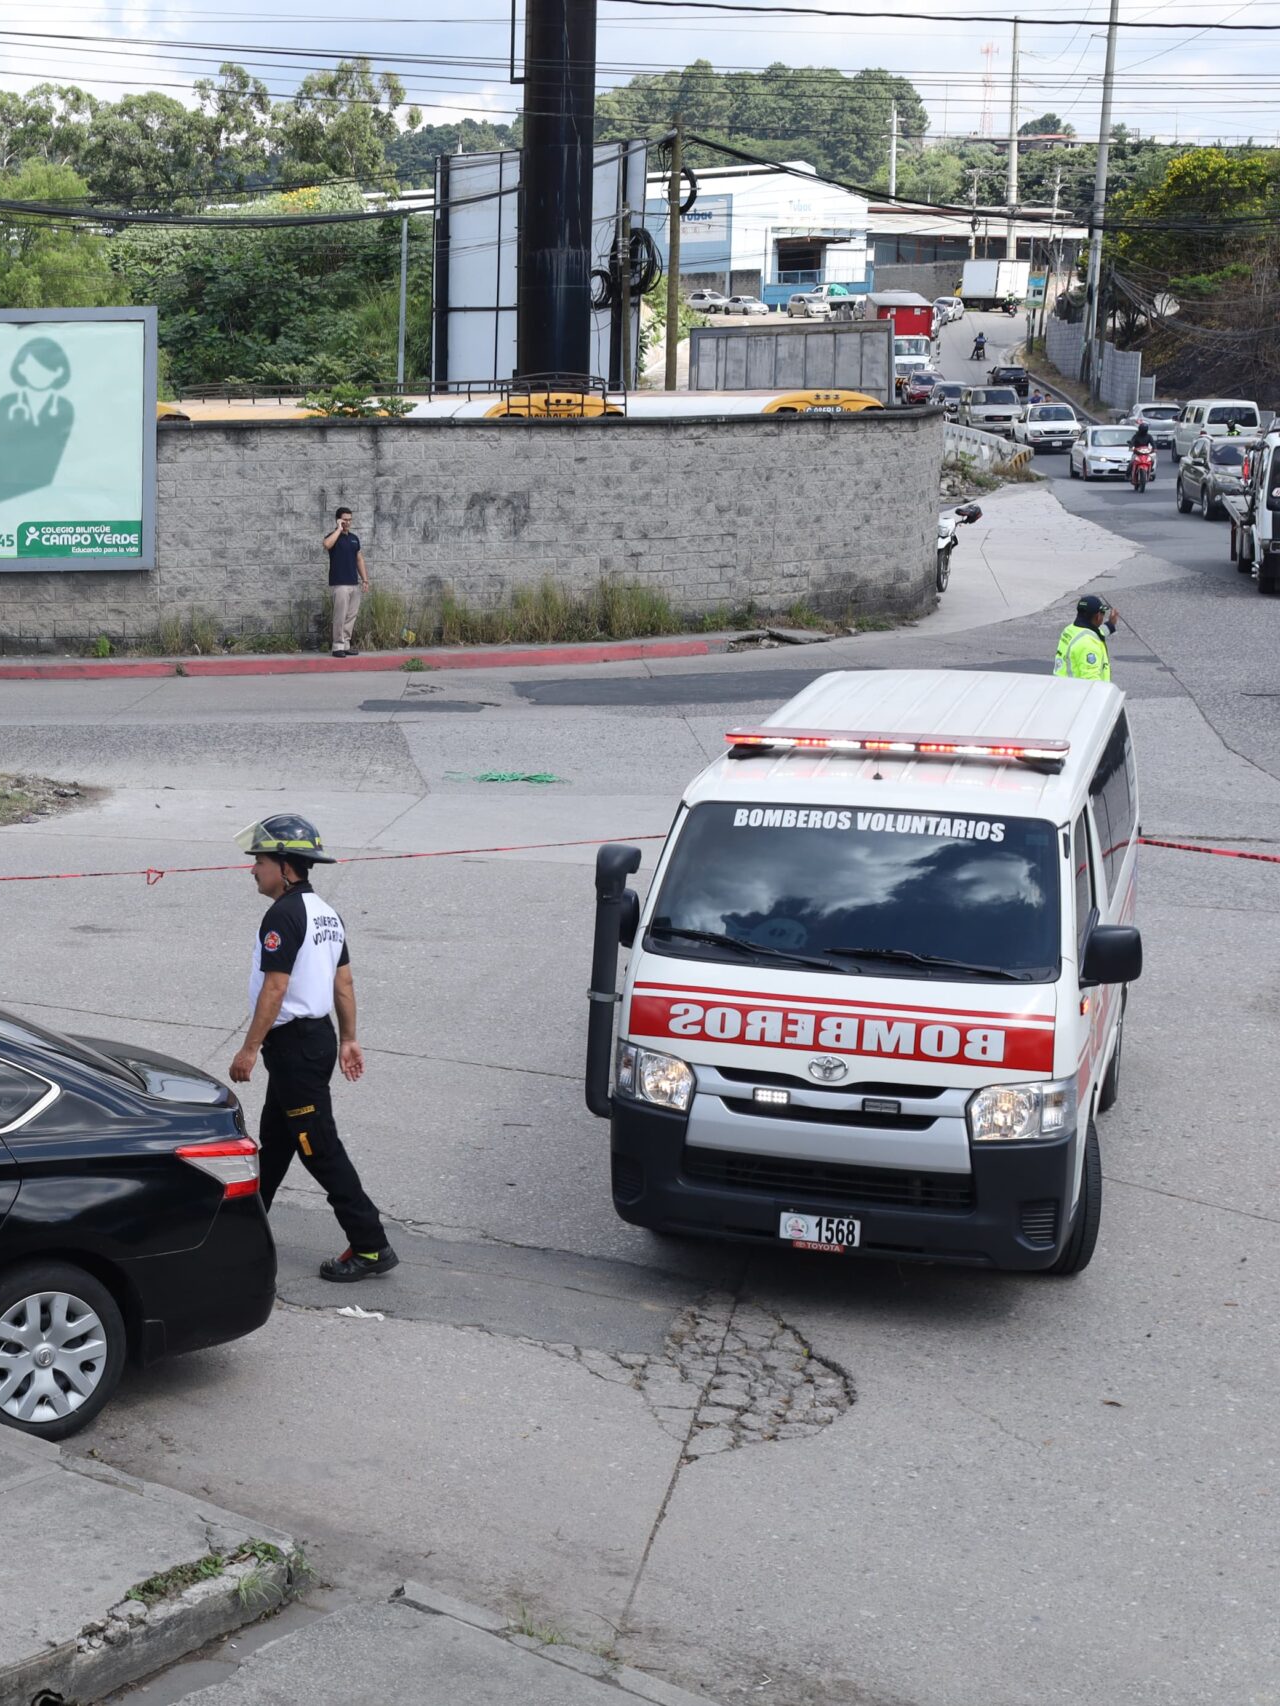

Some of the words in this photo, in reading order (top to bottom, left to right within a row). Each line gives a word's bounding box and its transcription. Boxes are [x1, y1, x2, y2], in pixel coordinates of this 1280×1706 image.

[41, 526, 74, 534] COLEGIO
[75, 524, 111, 533] BILINGÜE
[41, 533, 91, 545] CAMPO
[94, 533, 139, 544] VERDE
[733, 809, 852, 830] BOMBEROS
[856, 812, 1006, 842] VOLUNTARIOS
[815, 1216, 856, 1246] 1568
[807, 1241, 841, 1252] TOYOTA
